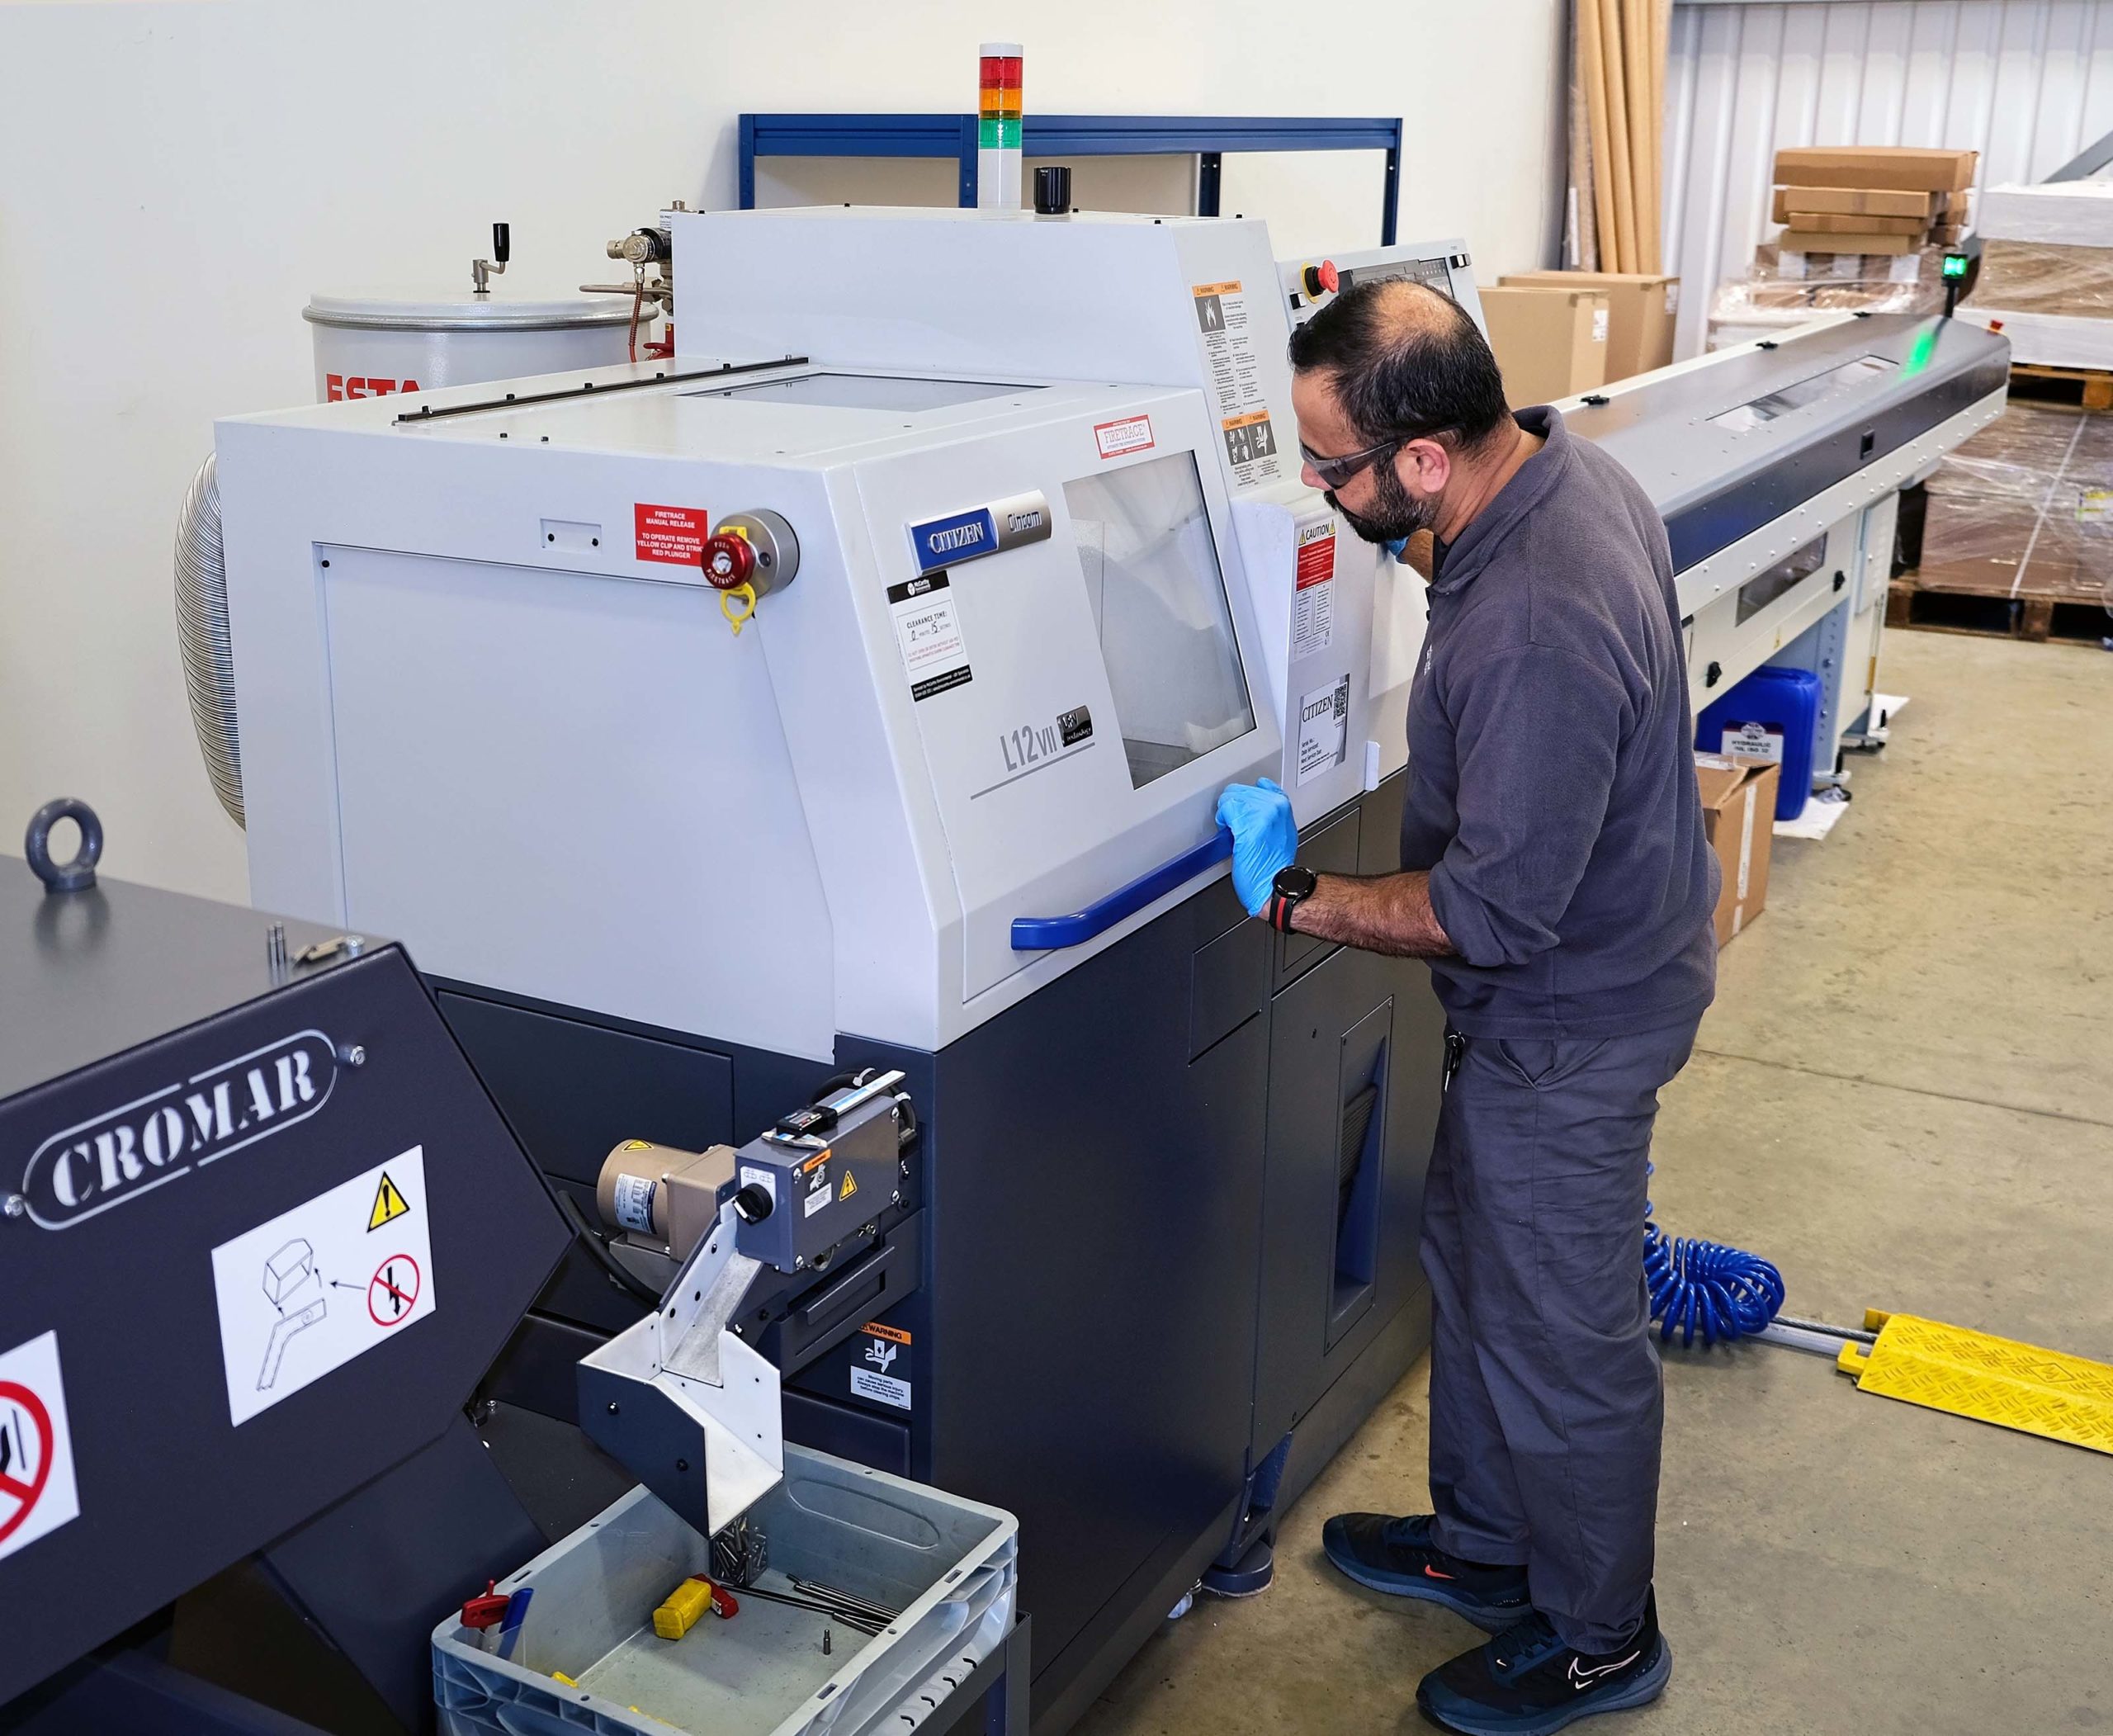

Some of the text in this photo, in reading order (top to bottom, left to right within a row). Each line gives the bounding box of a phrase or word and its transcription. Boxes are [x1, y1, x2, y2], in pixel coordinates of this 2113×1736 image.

[655, 511, 685, 520] FIRETRACE
[645, 518, 695, 529] MANUAL RELEASE
[929, 510, 1042, 554] CITIZEN Cincom
[1306, 523, 1330, 540] CAUTION
[637, 540, 659, 548] YELLOW
[652, 548, 691, 559] RED PLUNGER
[906, 614, 934, 629] CLEARANCE
[1302, 693, 1334, 723] CITIZEN
[53, 1050, 316, 1207] CROMAR
[869, 1325, 902, 1340] WARNING
[868, 1374, 882, 1384] Moving
[888, 1388, 905, 1397] machine
